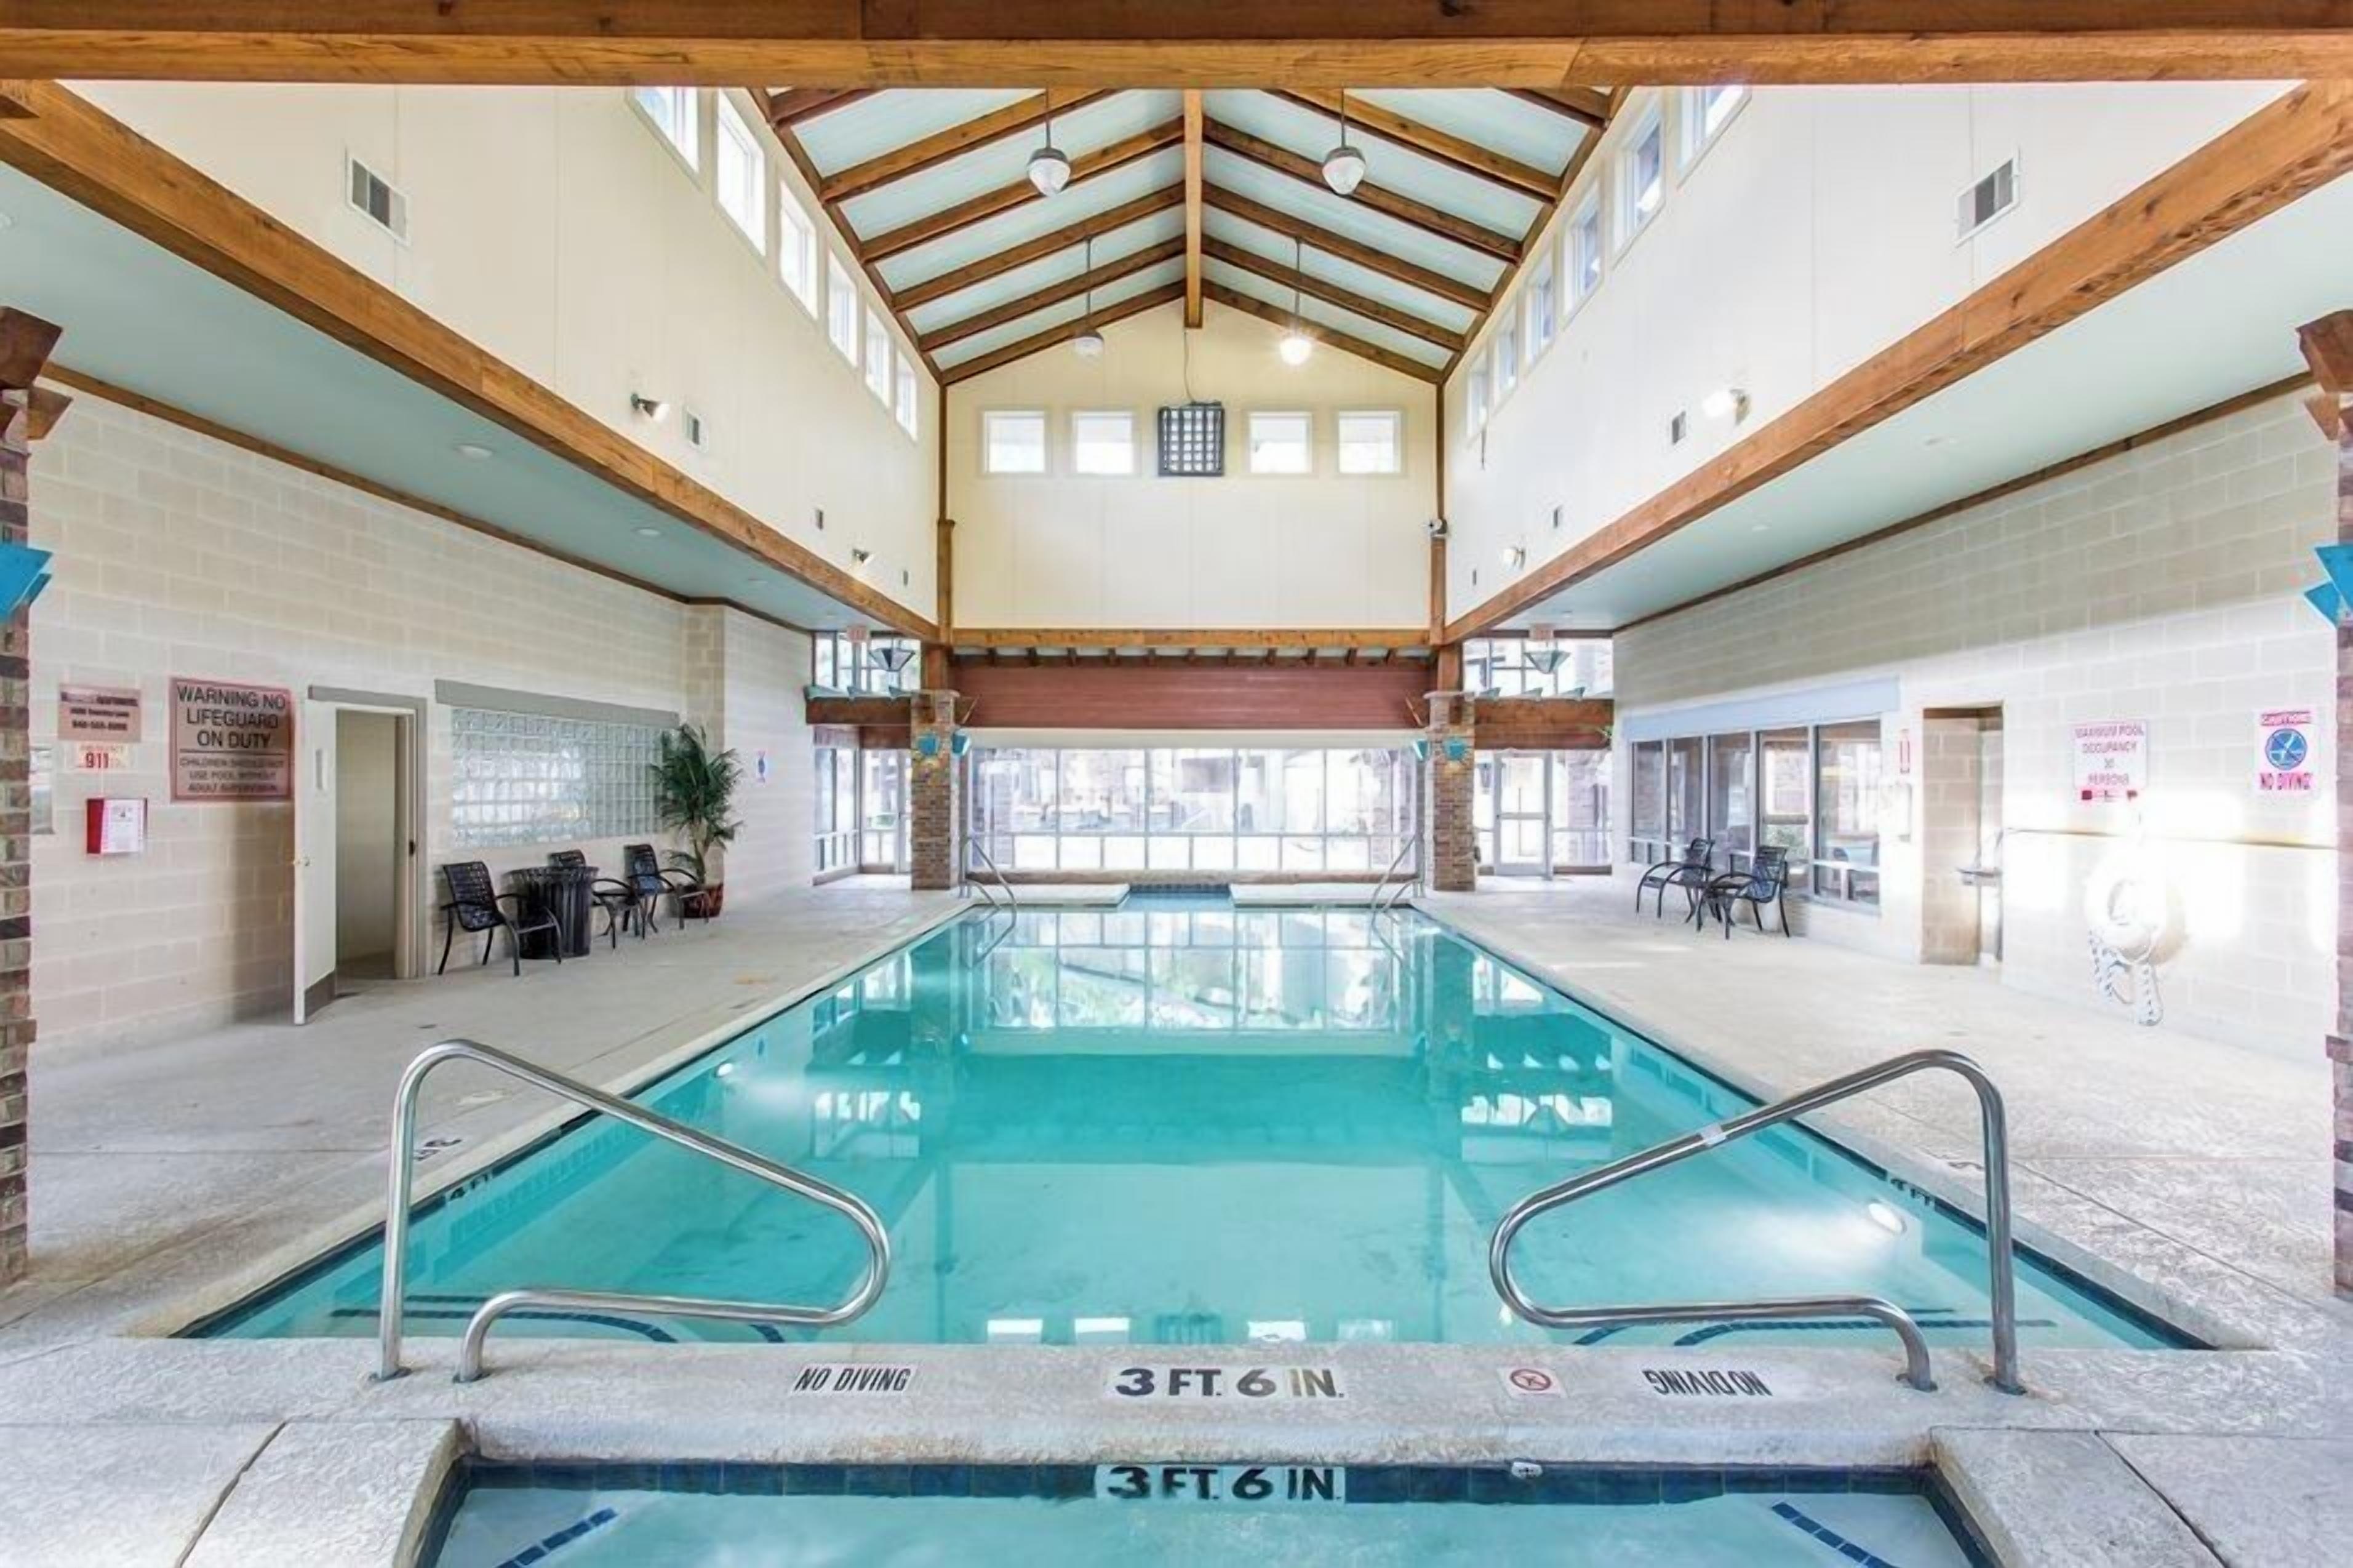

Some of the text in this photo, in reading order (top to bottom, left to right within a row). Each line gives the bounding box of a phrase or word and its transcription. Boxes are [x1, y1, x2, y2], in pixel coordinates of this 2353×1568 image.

[177, 686, 286, 709] WARNING NO
[187, 708, 279, 729] LIFEGUARD
[197, 730, 271, 748] ON DUTY
[2119, 725, 2144, 736] POOL
[2082, 740, 2137, 753] OCCUPANCY
[86, 752, 109, 769] 911
[2260, 773, 2312, 790] NO DIVING
[794, 1368, 911, 1391] NO DIVING
[1116, 1367, 1344, 1398] 3 FT. 6 IN.
[1642, 1369, 1773, 1396] NO DIVING
[1108, 1466, 1342, 1500] 3 FT. 6 IN.
